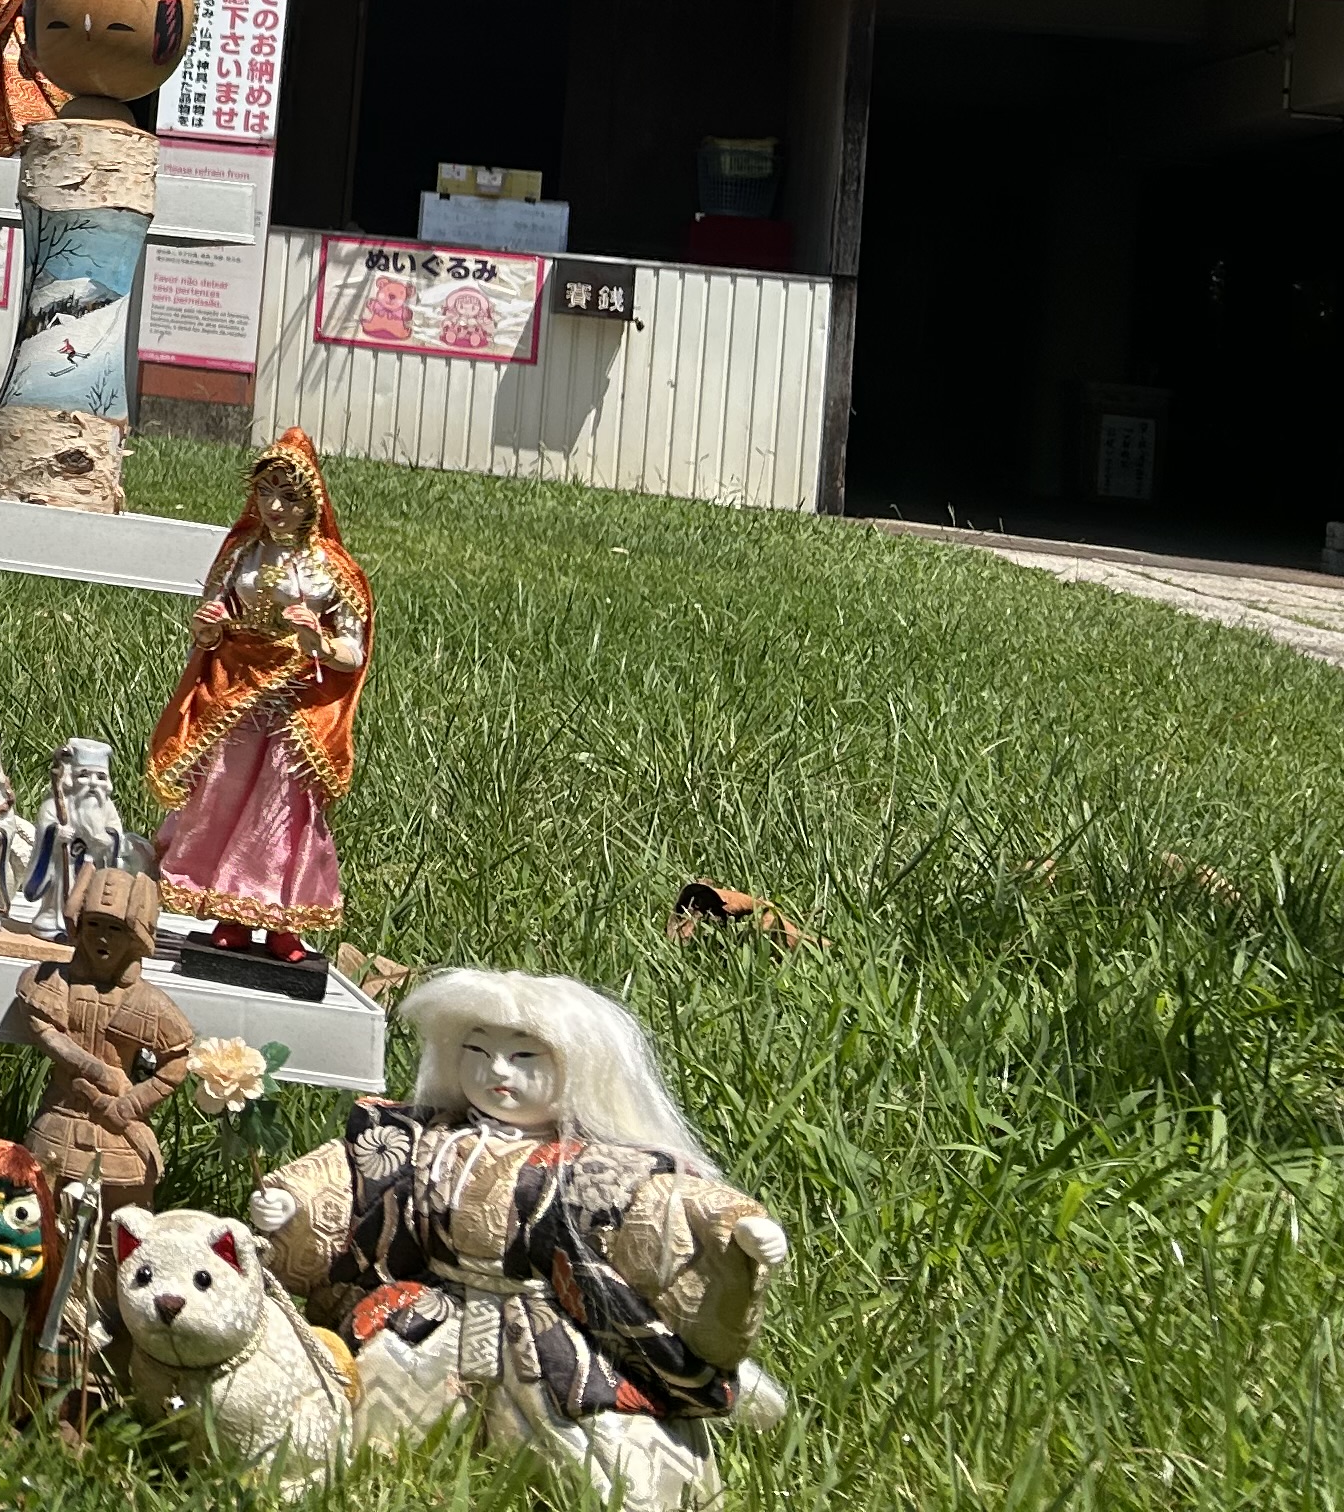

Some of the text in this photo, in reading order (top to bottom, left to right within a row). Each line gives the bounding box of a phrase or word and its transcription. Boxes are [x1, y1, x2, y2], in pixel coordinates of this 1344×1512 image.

[365, 249, 497, 282] ぬいぐるみ
